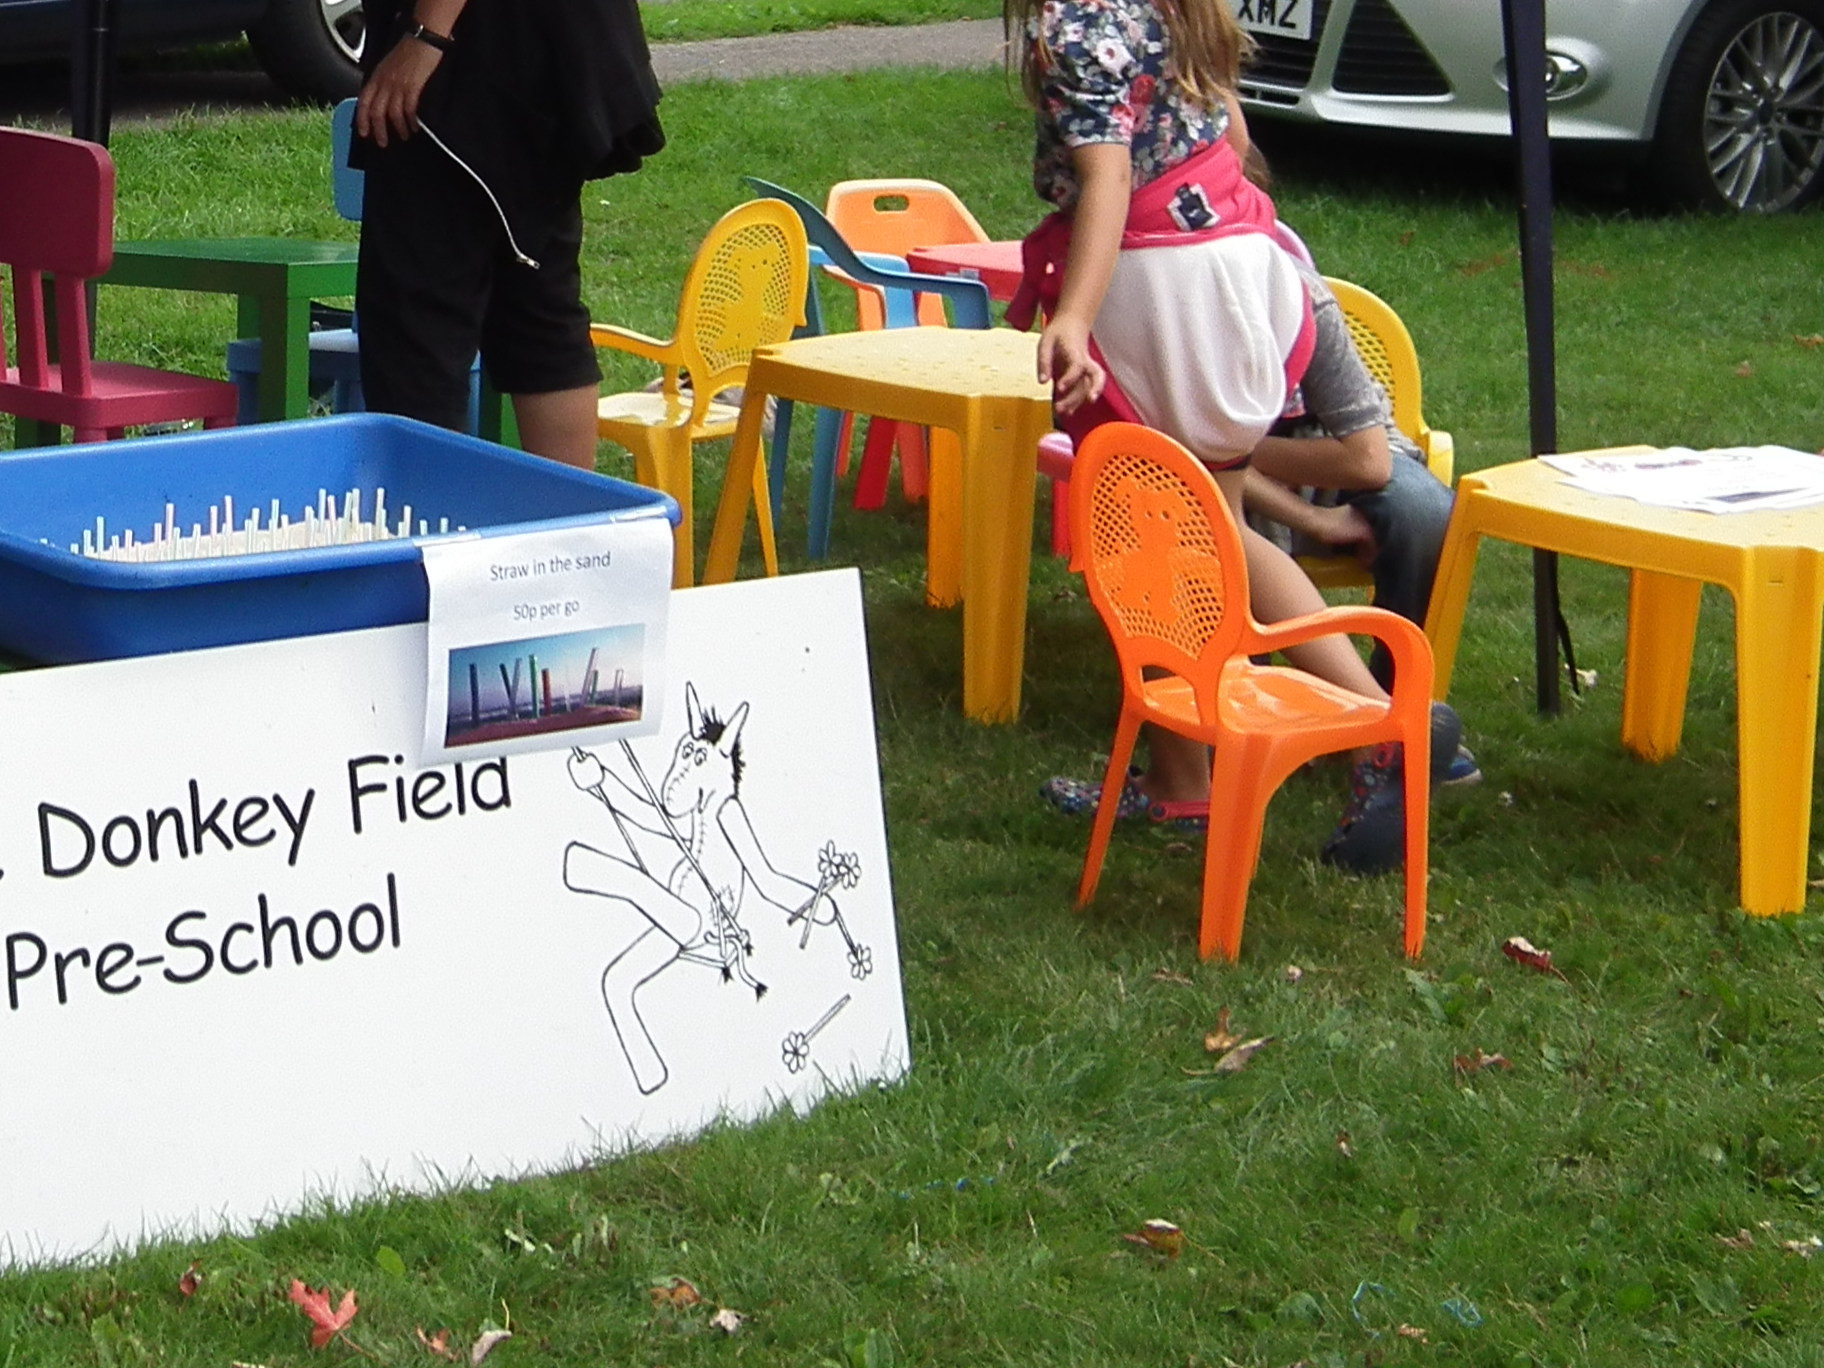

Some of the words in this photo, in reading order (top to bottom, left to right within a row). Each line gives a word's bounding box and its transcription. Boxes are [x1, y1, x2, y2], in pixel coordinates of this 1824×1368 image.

[490, 565, 530, 581] Straw
[532, 560, 547, 577] in
[549, 557, 574, 574] the
[575, 551, 612, 568] sand
[512, 604, 537, 622] 50p
[539, 603, 563, 620] per
[564, 600, 581, 616] go
[38, 780, 314, 877] Donkey
[348, 753, 511, 833] Field
[7, 873, 400, 1010] Pre-School
